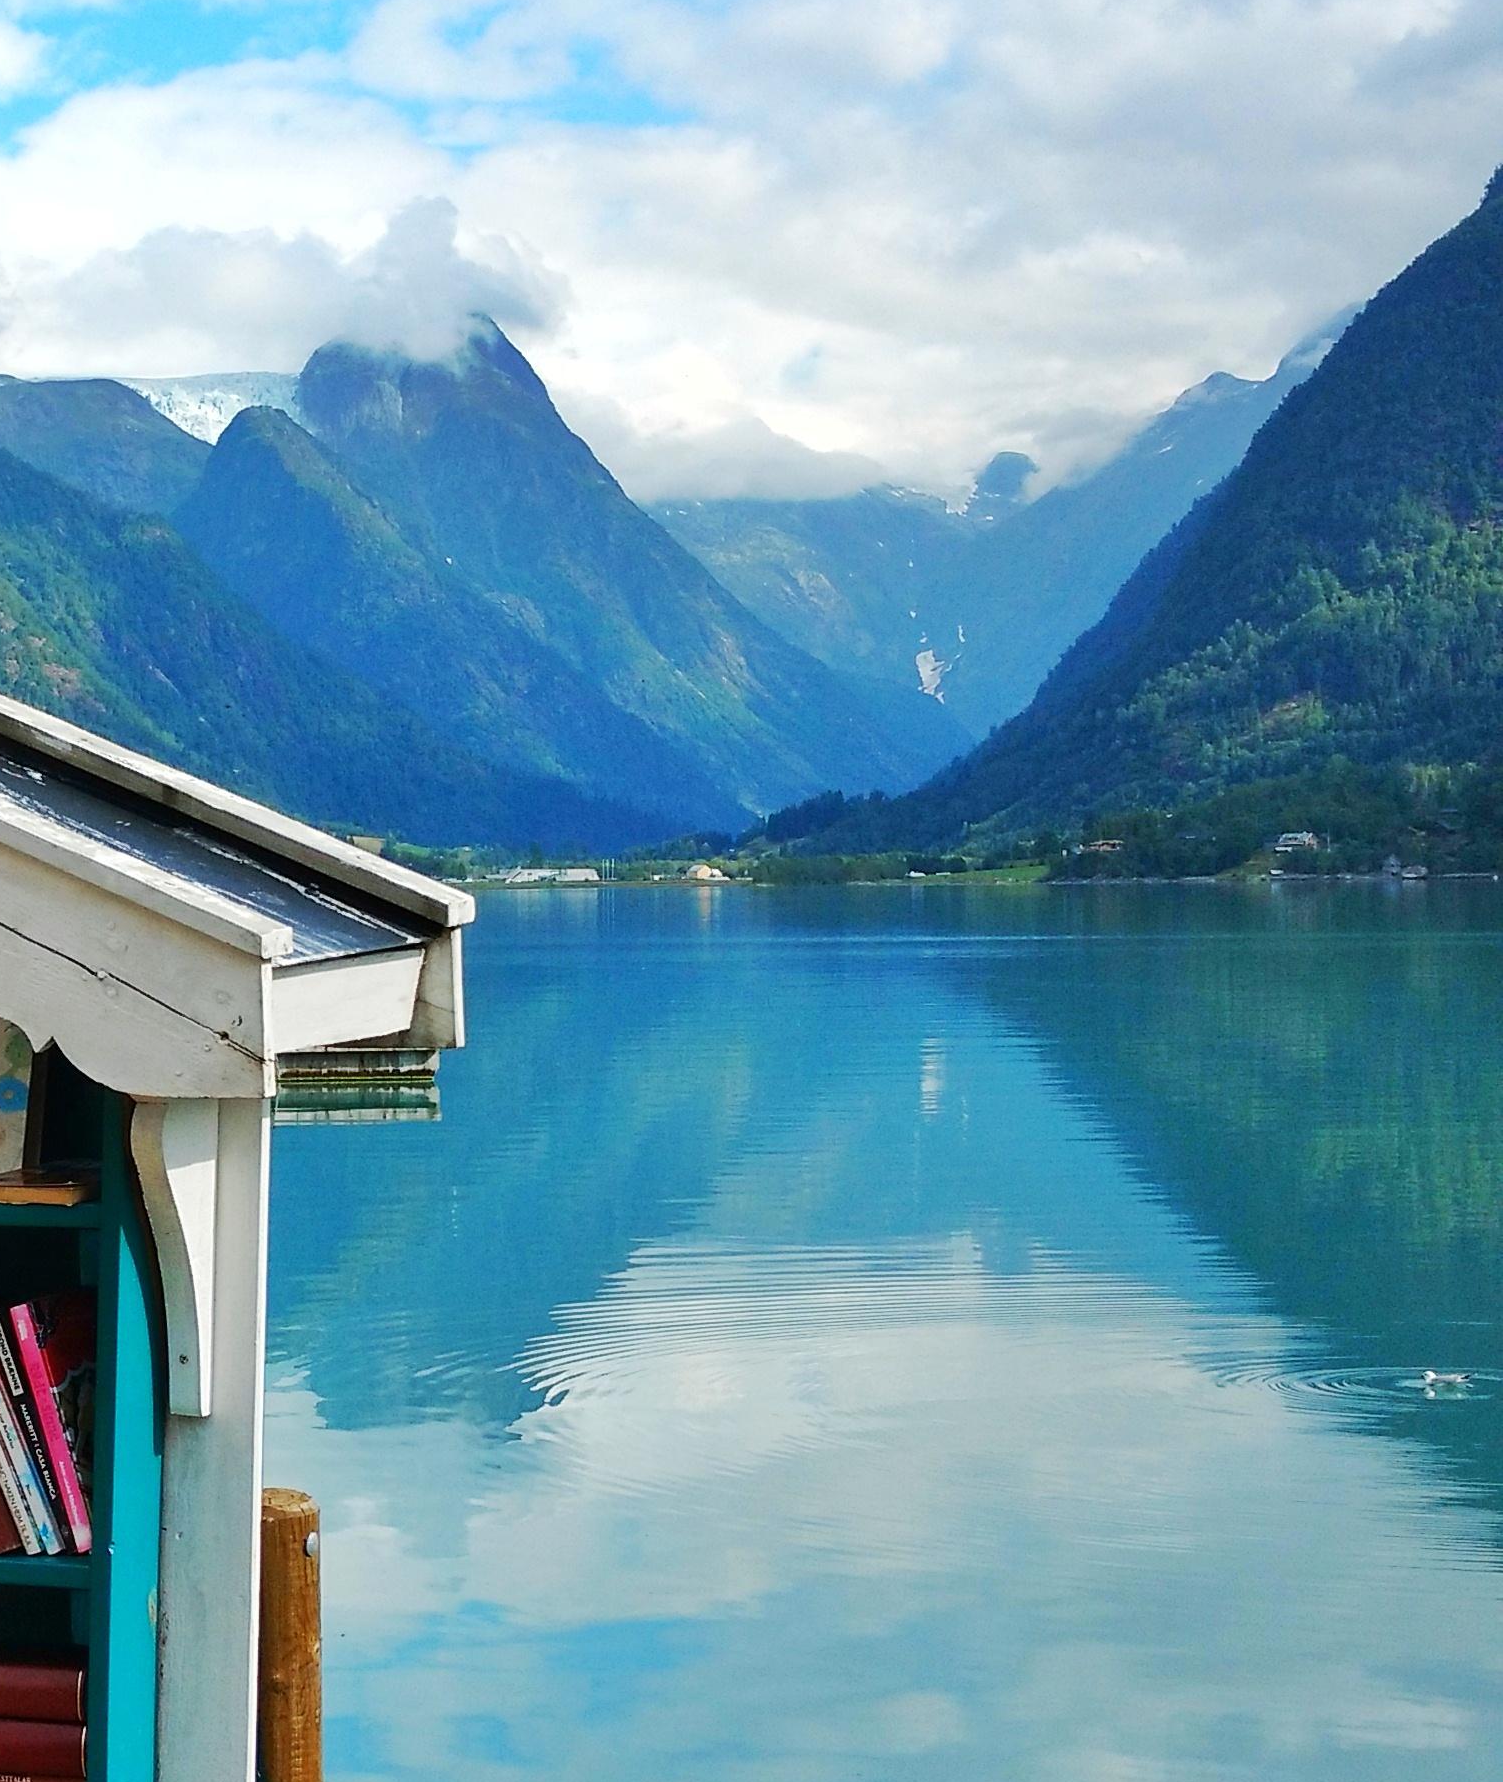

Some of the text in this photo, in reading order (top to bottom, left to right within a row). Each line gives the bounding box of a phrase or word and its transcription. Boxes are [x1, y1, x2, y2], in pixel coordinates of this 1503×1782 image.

[2, 1356, 22, 1390] BRÆNNE
[18, 1402, 39, 1442] MARERITT
[34, 1447, 47, 1469] CASA
